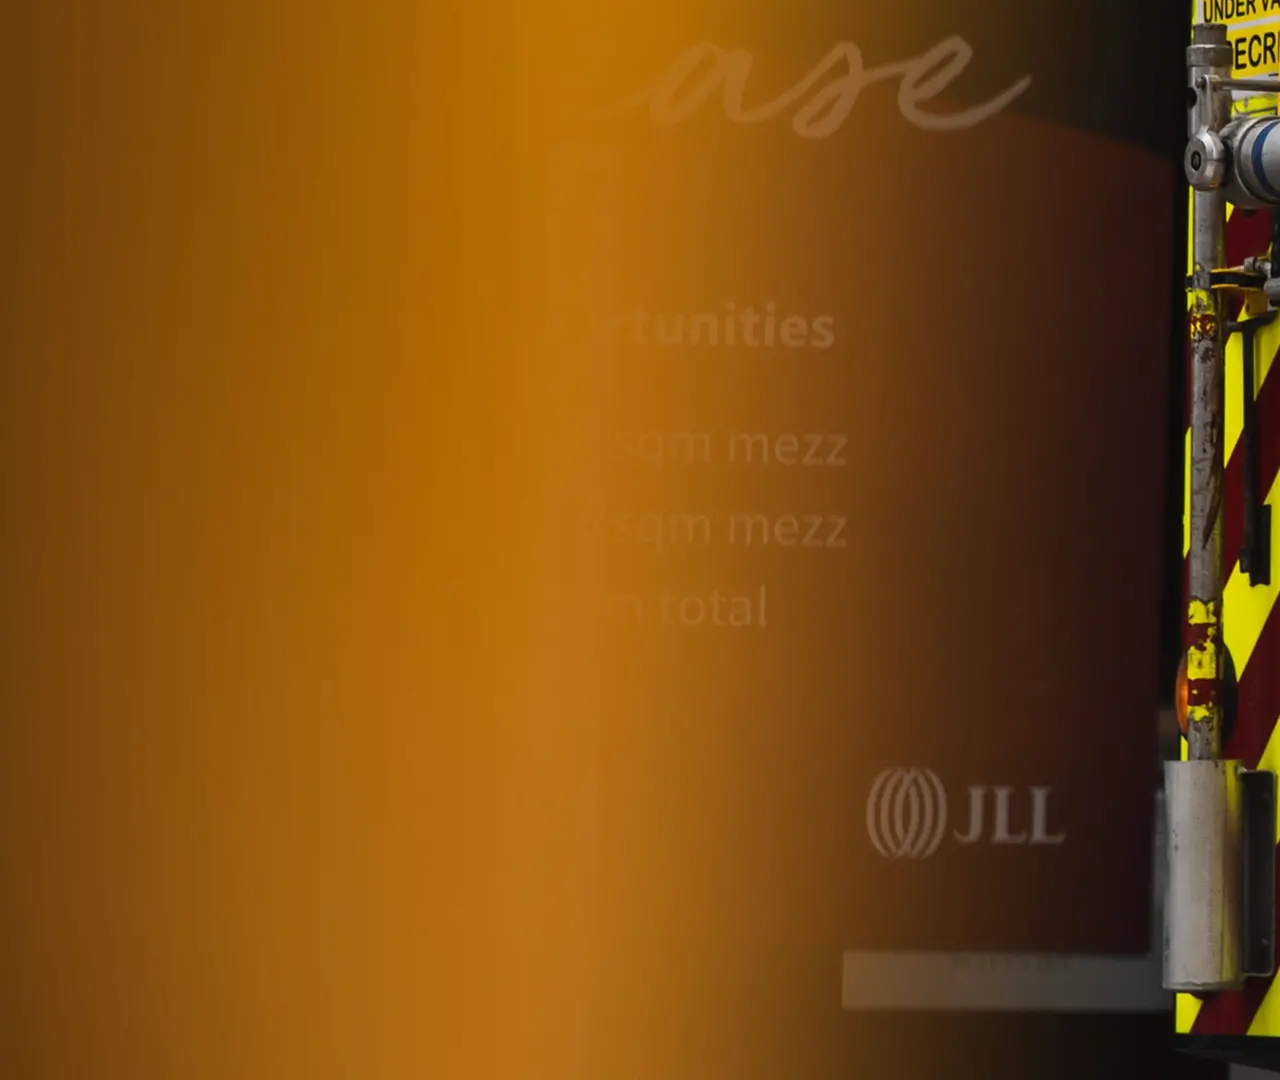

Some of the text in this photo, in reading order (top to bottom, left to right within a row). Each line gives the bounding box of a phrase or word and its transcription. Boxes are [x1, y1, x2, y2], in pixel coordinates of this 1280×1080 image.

[635, 33, 1034, 140] ase
[728, 431, 848, 468] mezz
[728, 512, 848, 549] mezz
[659, 584, 768, 628] total
[953, 785, 1066, 846] JLL
